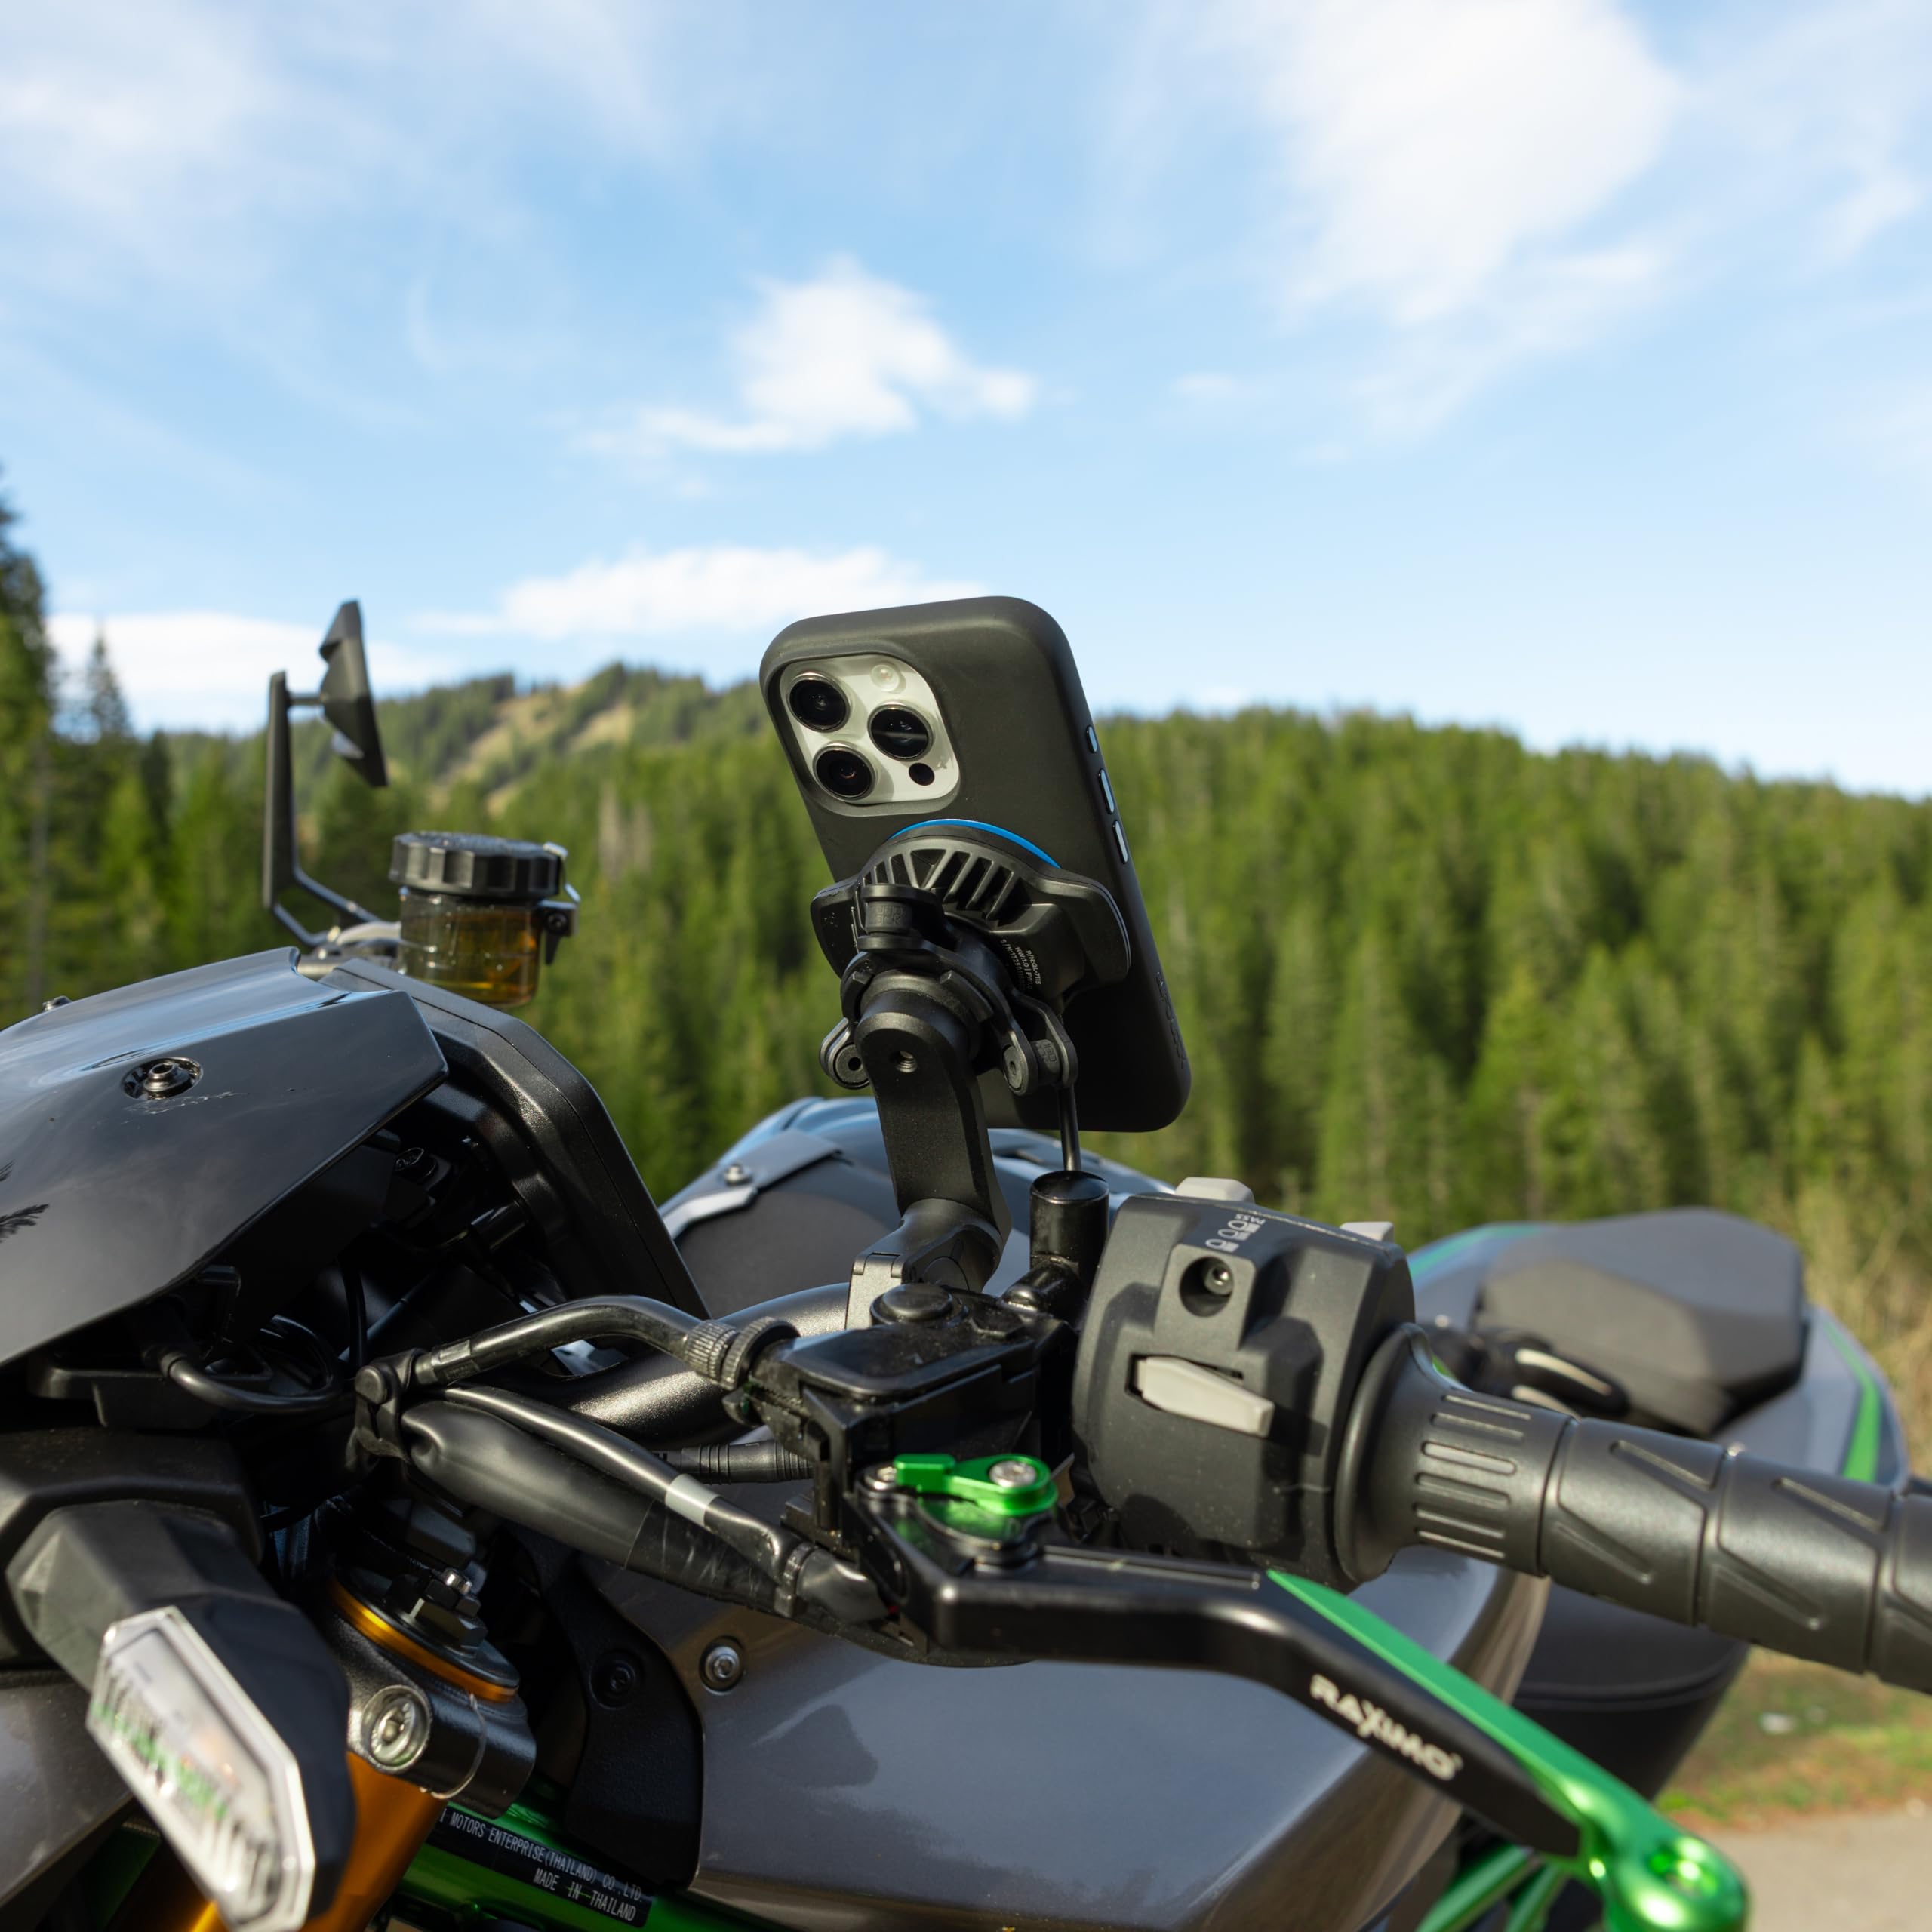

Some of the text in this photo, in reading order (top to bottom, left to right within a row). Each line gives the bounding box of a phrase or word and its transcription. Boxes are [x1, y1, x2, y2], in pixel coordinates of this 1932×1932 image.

[452, 1811, 486, 1838] MOTORS
[533, 1867, 637, 1922] MADE IN THAILAND
